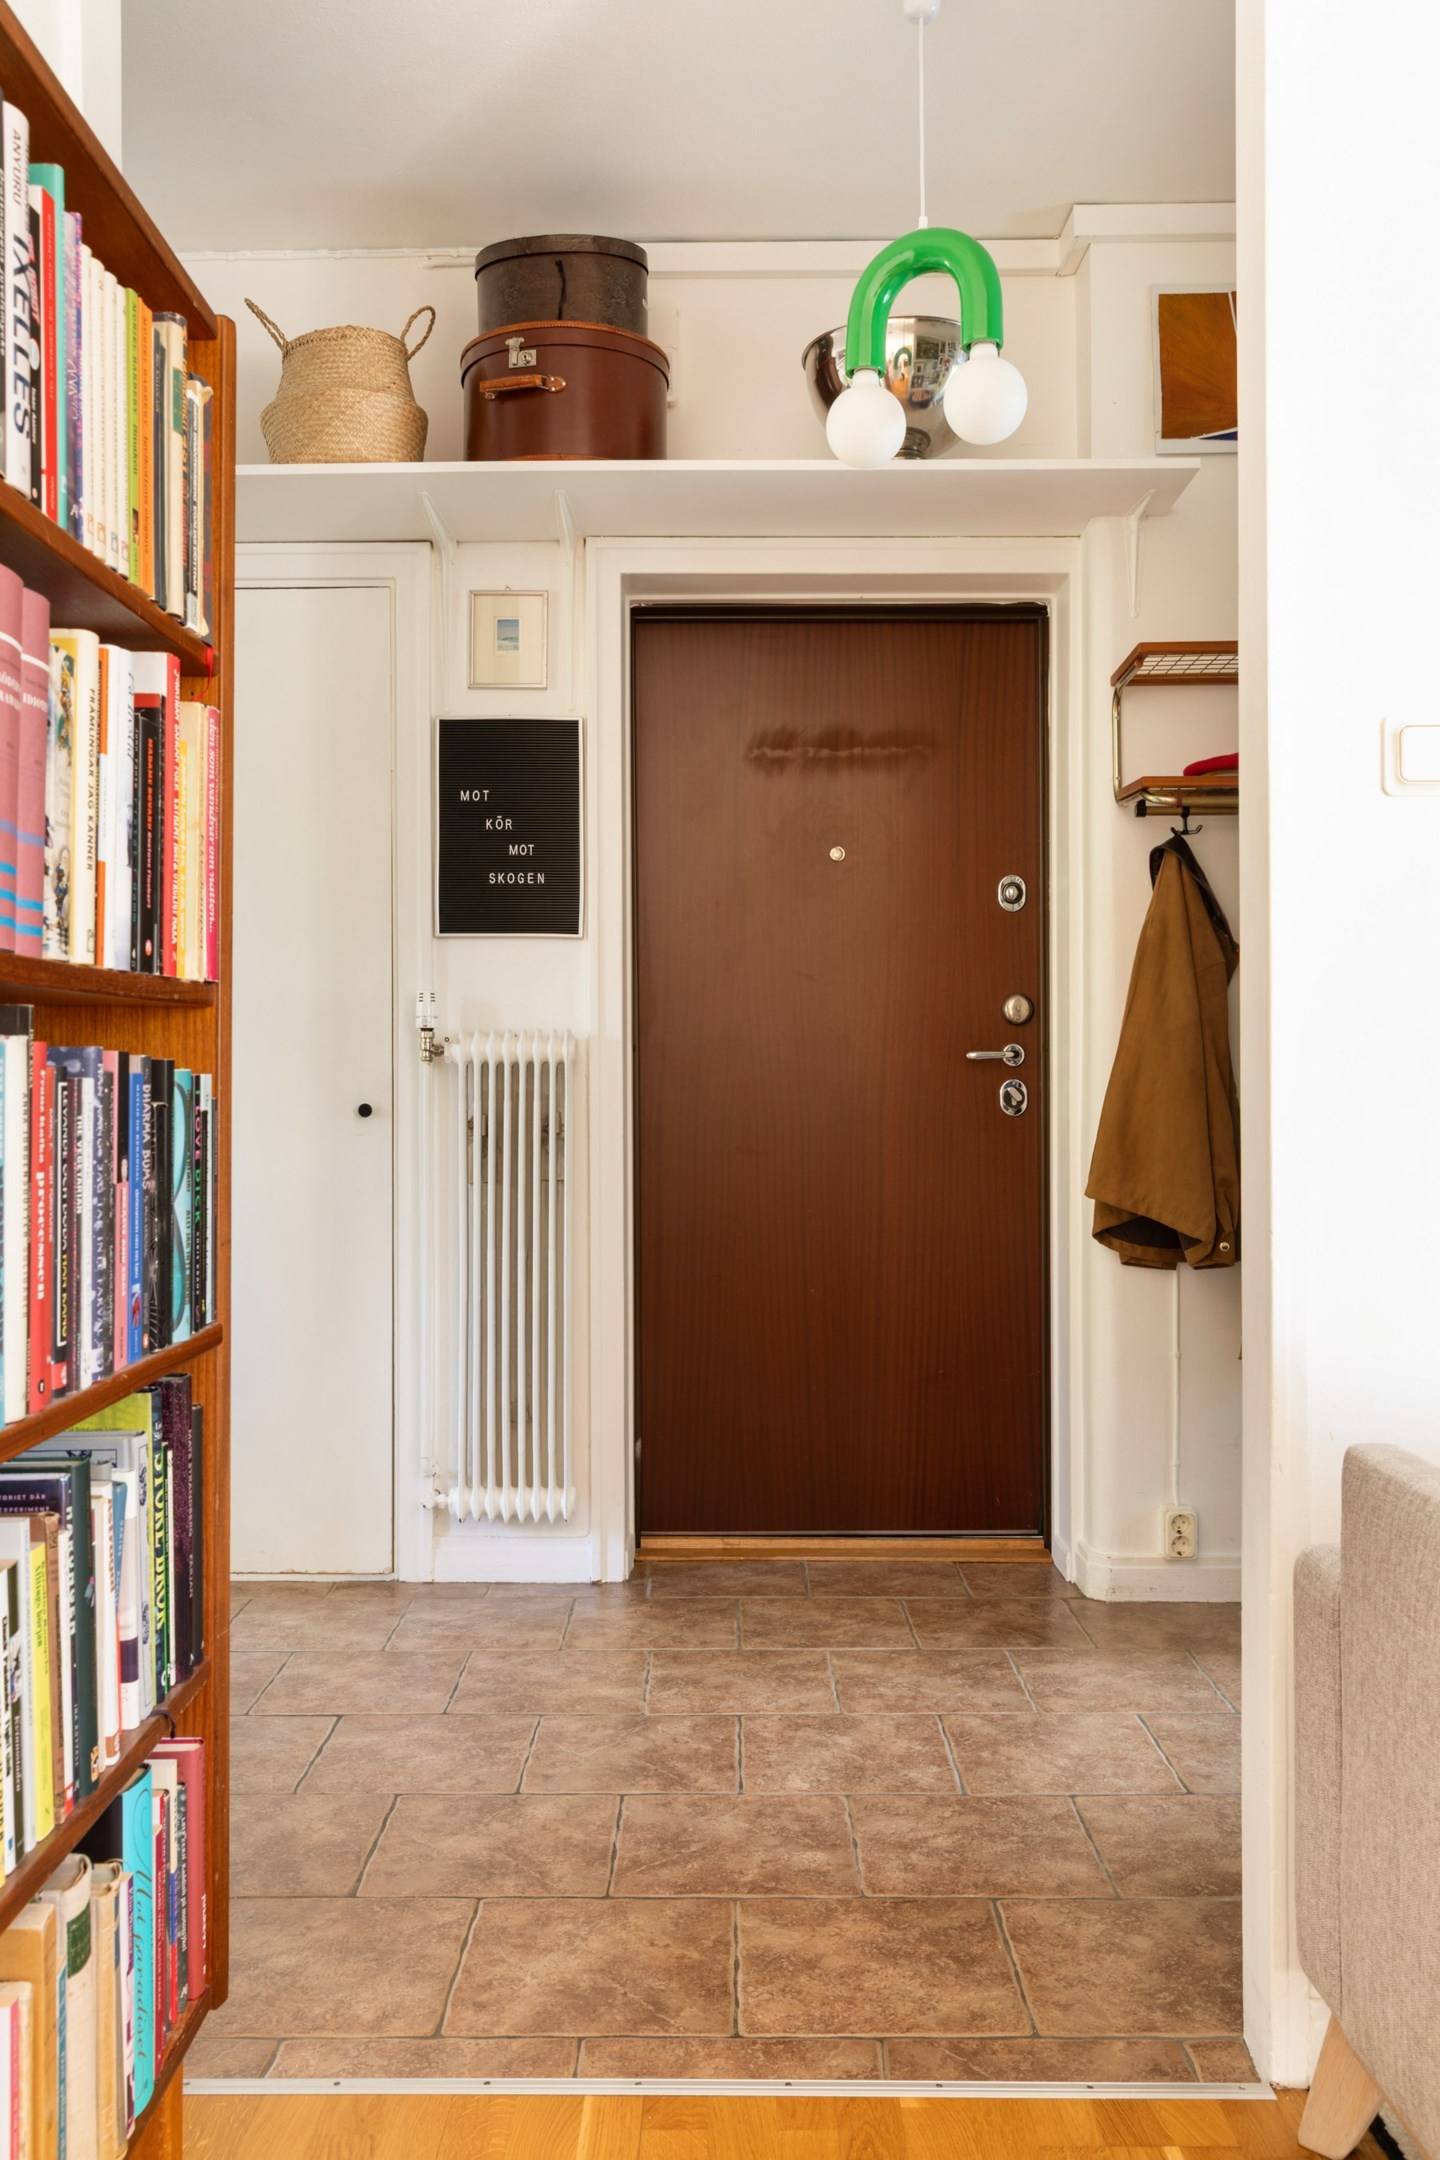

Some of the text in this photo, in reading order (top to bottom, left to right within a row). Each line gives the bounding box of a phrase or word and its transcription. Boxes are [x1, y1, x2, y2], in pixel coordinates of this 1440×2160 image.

[12, 129, 21, 204] ANYURU
[13, 233, 31, 438] IXELLES
[209, 718, 217, 747] den
[460, 790, 490, 802] MOT
[485, 815, 513, 830] KÖR
[209, 846, 215, 869] om
[508, 844, 535, 857] MOT
[488, 872, 546, 885] SKOGEN
[142, 1084, 151, 1143] DHARMA
[142, 1149, 151, 1189] BUMS
[36, 1171, 45, 1300] processen
[134, 1871, 153, 2059] Mot paradiset
